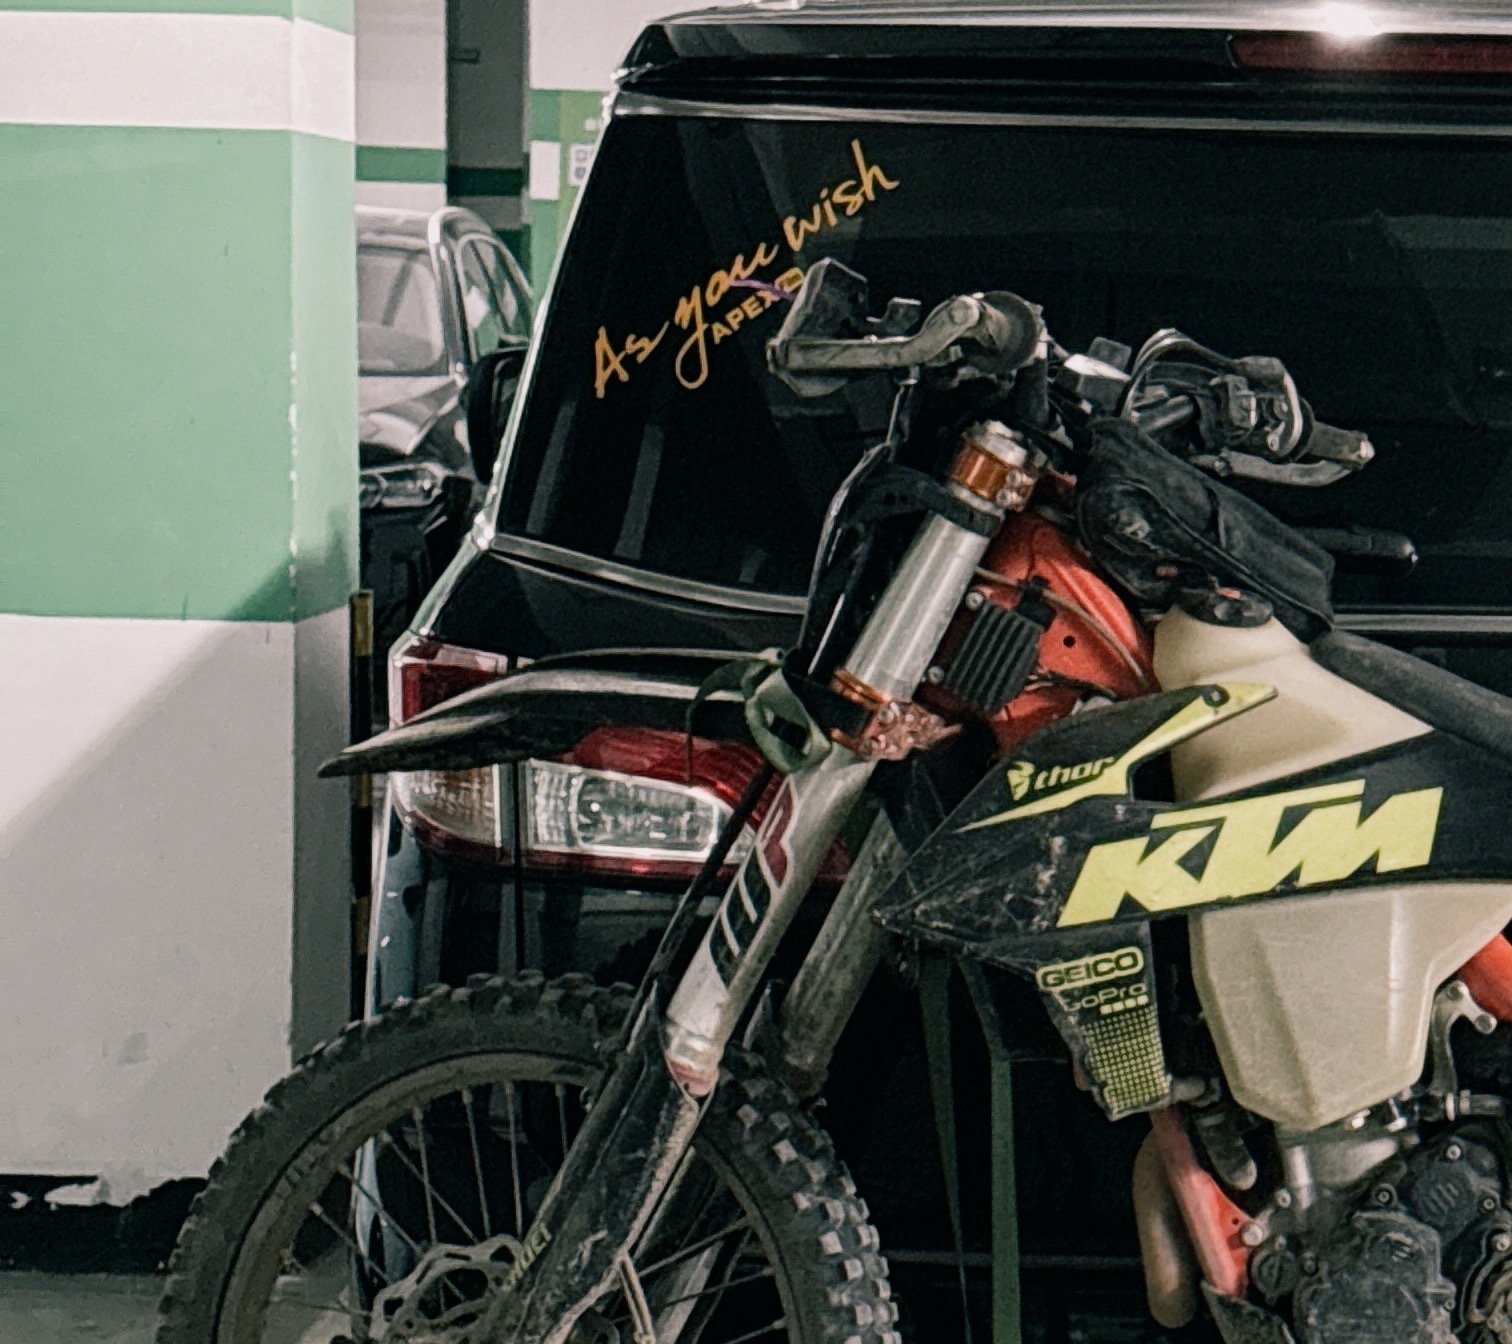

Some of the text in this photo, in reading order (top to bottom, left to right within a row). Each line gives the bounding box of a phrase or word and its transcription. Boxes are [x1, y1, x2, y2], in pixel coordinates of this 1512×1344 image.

[595, 139, 900, 399] As you wish
[1057, 779, 1444, 928] KTM
[1041, 951, 1139, 988] GEICO
